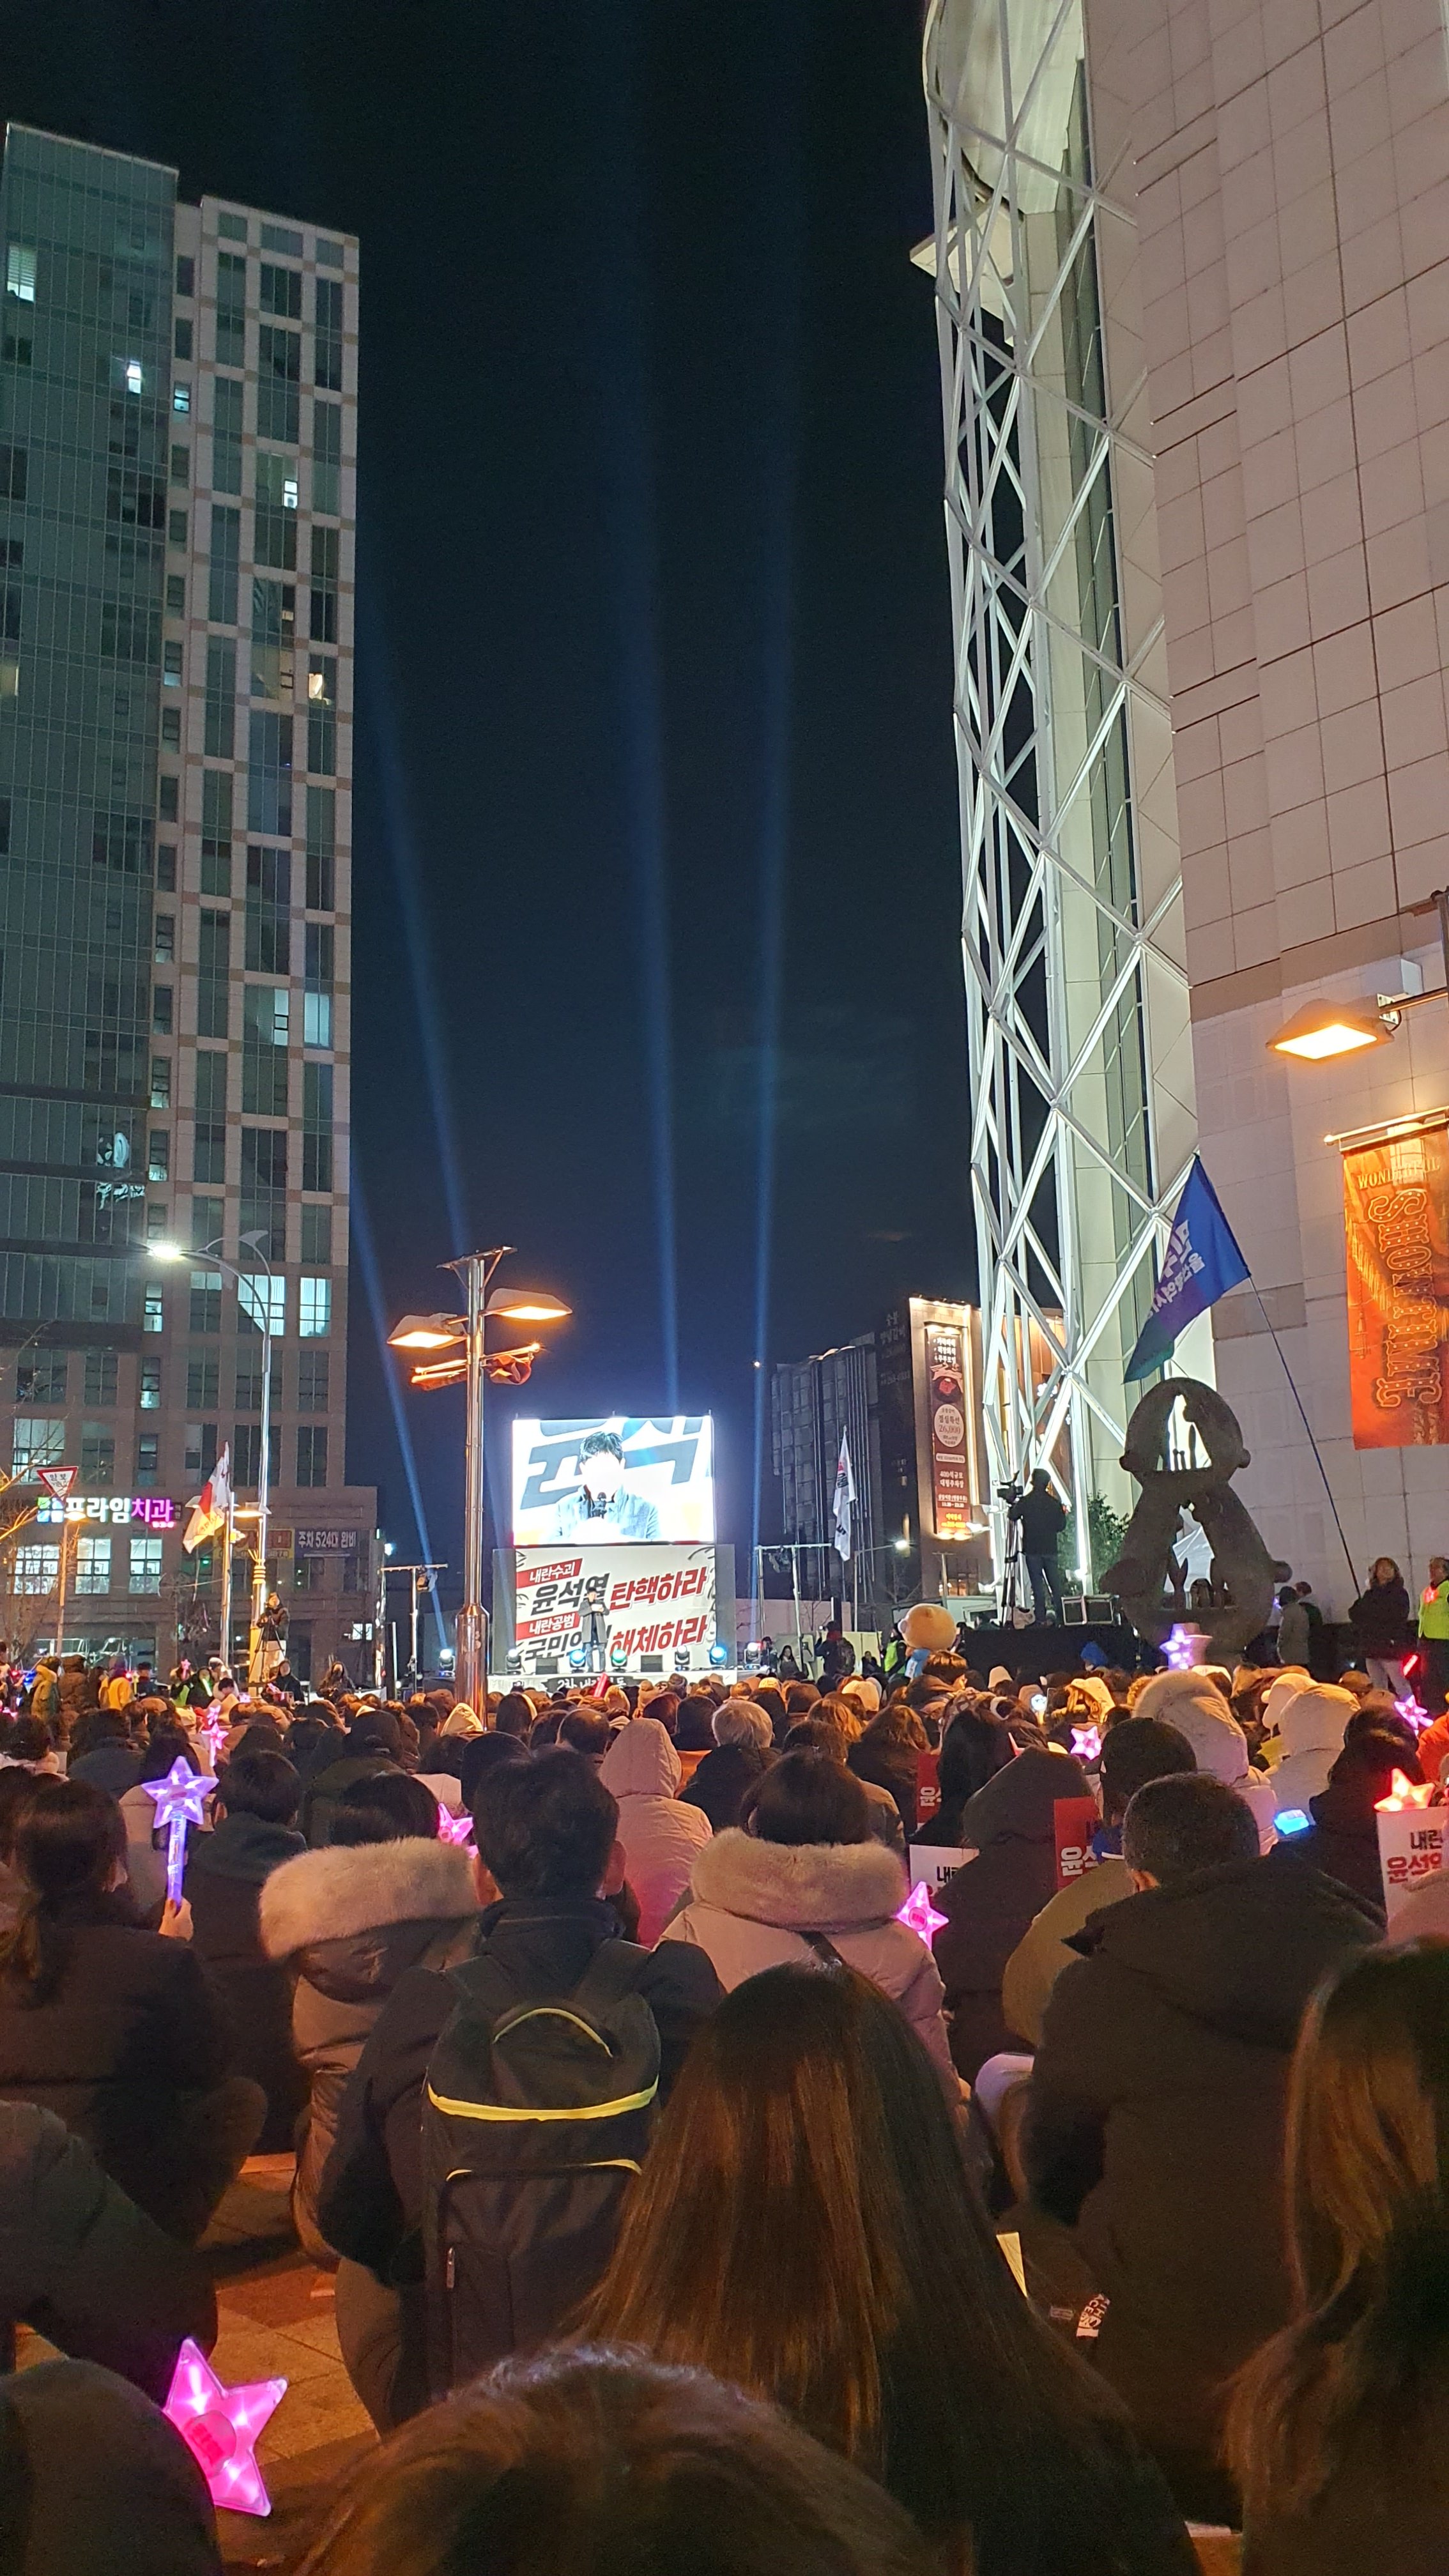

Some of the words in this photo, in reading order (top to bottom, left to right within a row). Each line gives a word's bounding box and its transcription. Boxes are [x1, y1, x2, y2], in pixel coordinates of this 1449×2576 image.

[1368, 1188, 1443, 1407] SHOWTIME
[66, 1497, 174, 1523] 프라임치과
[298, 1531, 314, 1548] 주차
[341, 1531, 356, 1548] 완비
[529, 1561, 576, 1583] 내란수괴
[610, 1567, 707, 1611] 탄핵하라
[529, 1613, 576, 1635] 내란공범
[610, 1614, 708, 1658] 해체하라
